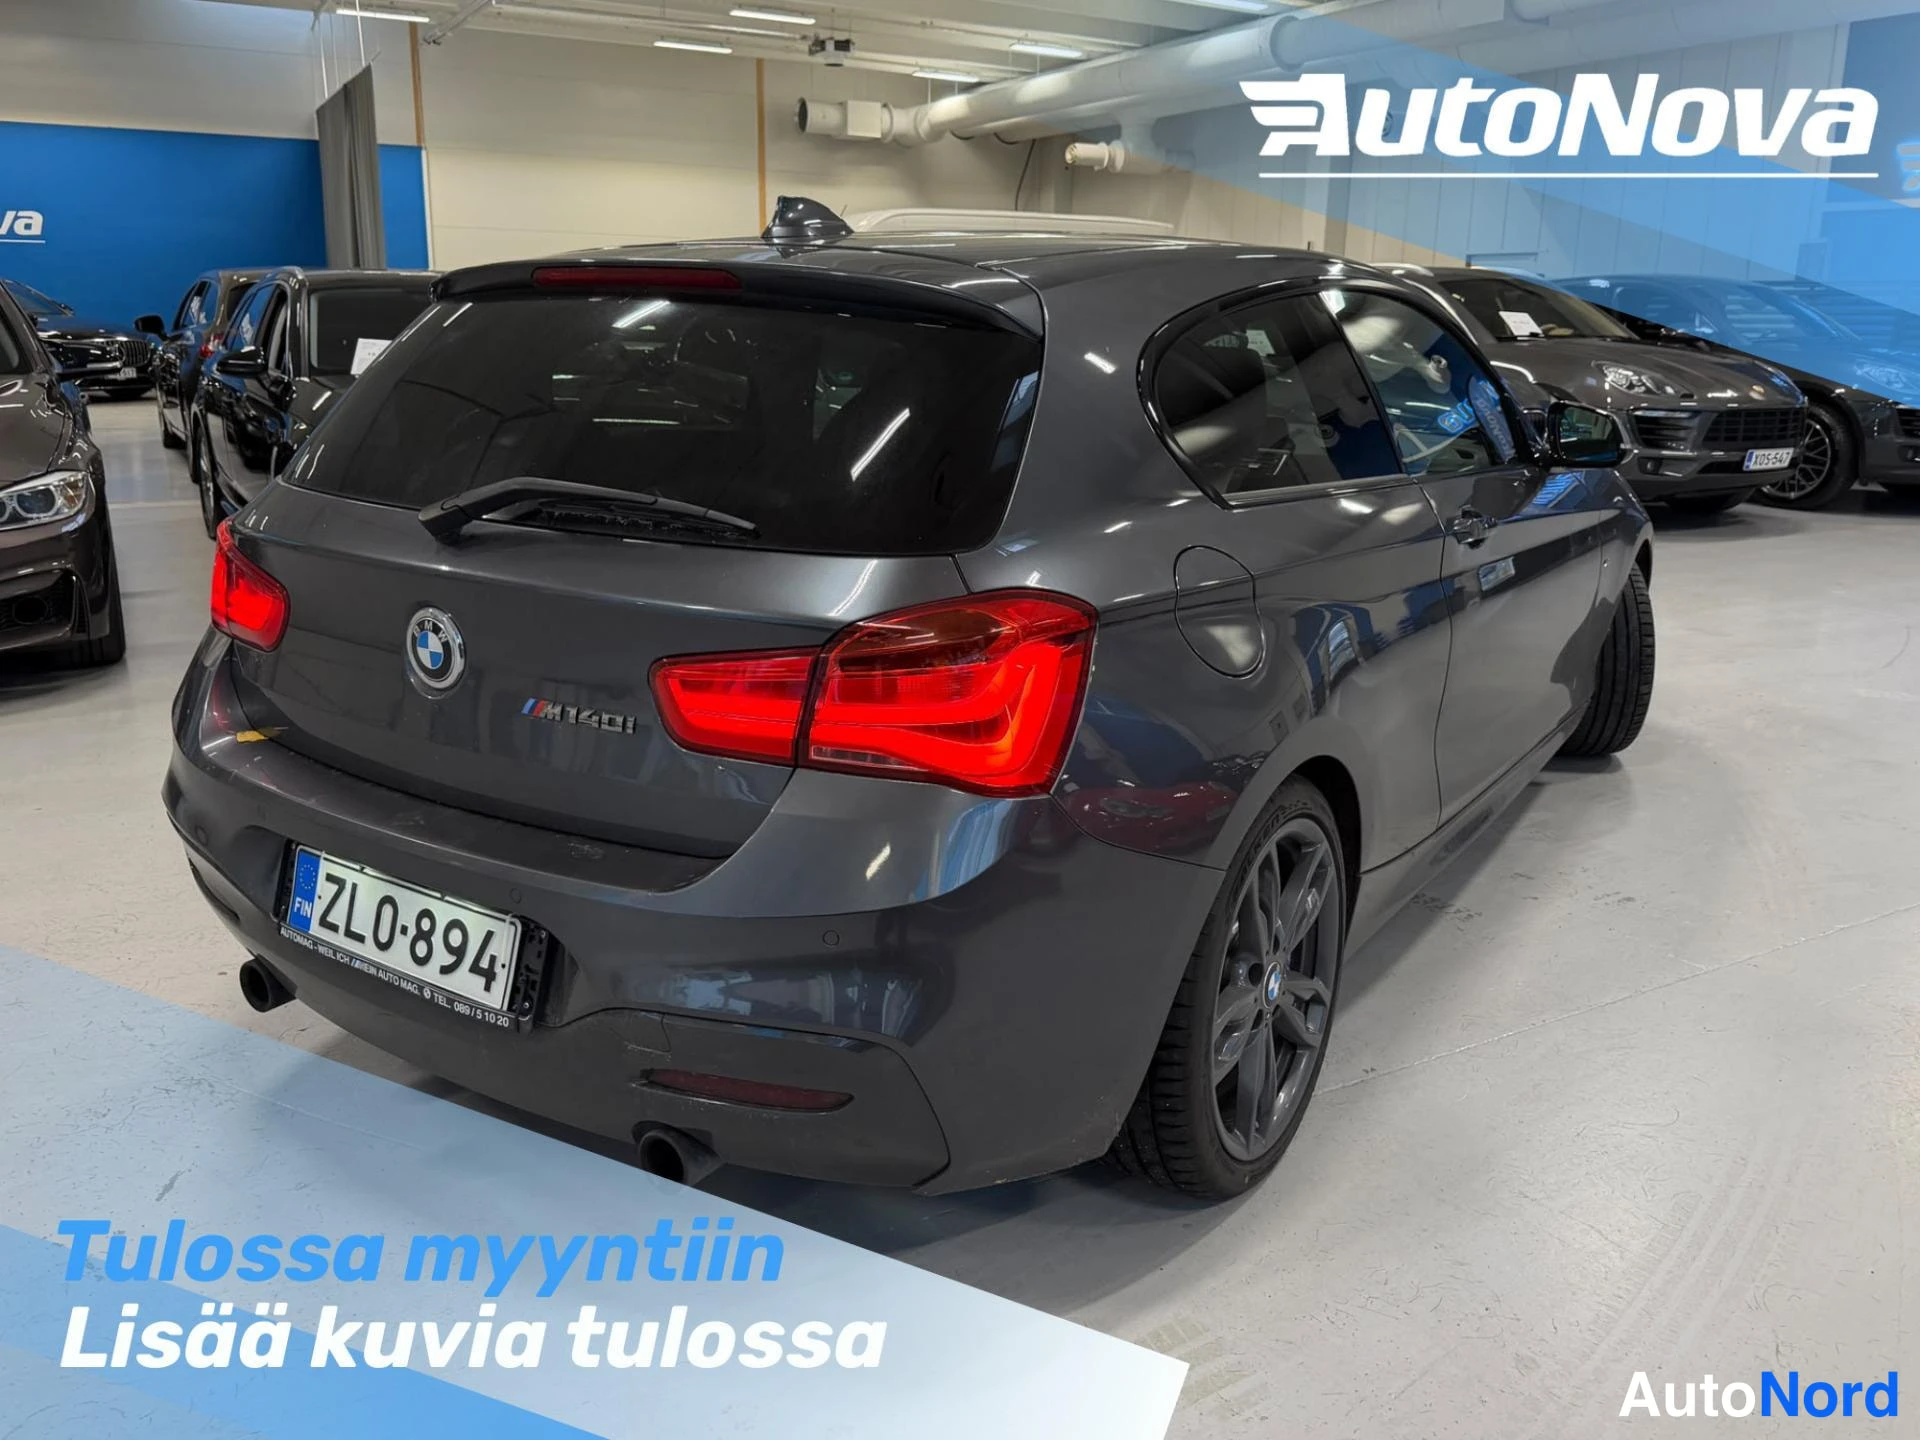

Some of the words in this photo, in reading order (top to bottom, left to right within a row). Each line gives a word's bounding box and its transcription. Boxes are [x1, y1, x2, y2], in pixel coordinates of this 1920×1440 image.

[293, 897, 312, 918] FIN
[318, 872, 498, 993] ZLO-894
[280, 927, 313, 950] AUTOMAG
[318, 945, 336, 960] WEIL
[337, 952, 350, 966] ICH
[378, 969, 400, 986] AUTO
[400, 978, 421, 996] MAG.
[433, 992, 451, 1009] TEL.
[497, 1016, 510, 1028] 20
